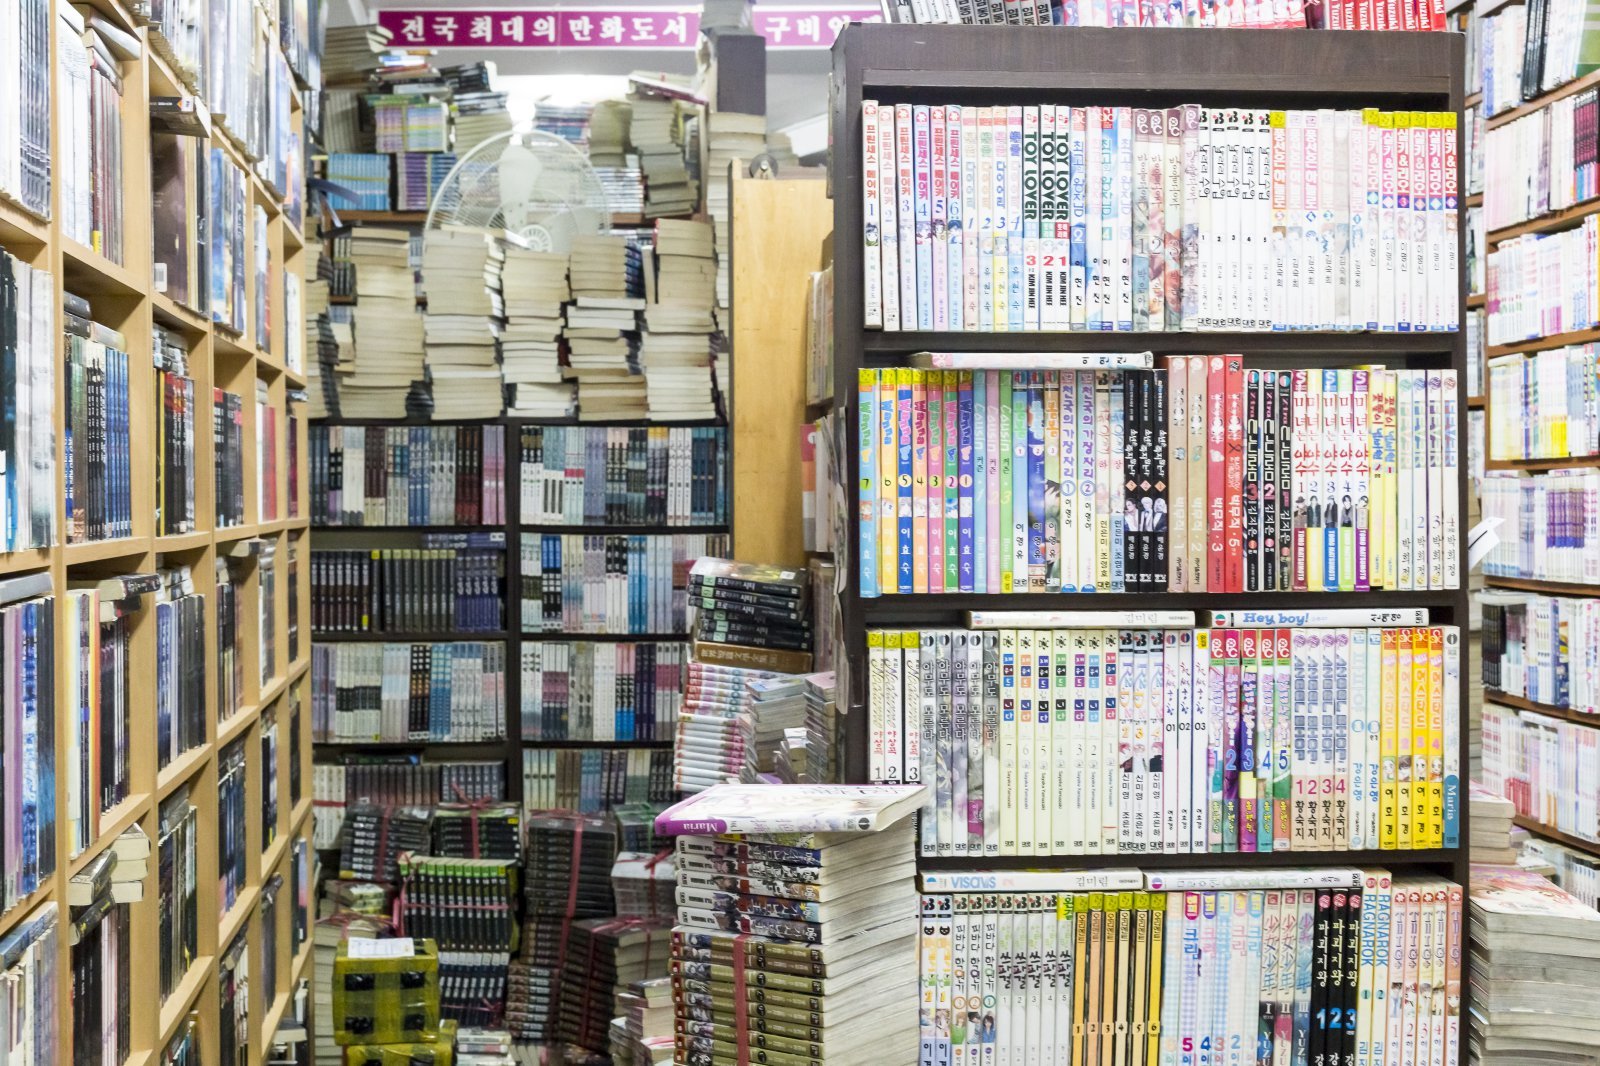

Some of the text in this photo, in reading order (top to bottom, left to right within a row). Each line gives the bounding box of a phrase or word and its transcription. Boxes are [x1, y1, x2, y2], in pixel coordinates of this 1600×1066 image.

[400, 16, 688, 42] 전국 최대의 만화도서
[1345, 1, 1354, 30] Yuzuk
[1359, 1, 1369, 30] Yuzuk
[1376, 1, 1386, 30] Yuzuk
[1024, 132, 1037, 220] TOY LOVER
[1042, 132, 1055, 220] TOY LOVER
[1056, 132, 1069, 220] TOY LOVER
[1026, 255, 1036, 266] 3
[1043, 255, 1054, 266] 2
[1060, 256, 1067, 266] 1
[1278, 612, 1309, 625] boy!
[1294, 655, 1305, 713] ANGEL
[1307, 655, 1318, 713] ANGEL
[1322, 655, 1333, 712] ANGEL
[1336, 654, 1347, 712] ANGEL
[922, 661, 936, 742] 아무도 모른다
[938, 660, 951, 741] 아무도 모른다
[954, 660, 967, 741] 아무도 모른다
[969, 661, 982, 741] 아무도 모른다
[985, 661, 998, 742] 아무도 모른다
[1165, 724, 1176, 732] 01
[1180, 722, 1190, 731] 02
[1194, 722, 1206, 730] 03
[875, 767, 881, 779] 1
[888, 766, 896, 779] 2
[909, 767, 918, 780] 3
[1213, 750, 1218, 770] 1
[1225, 749, 1237, 770] 2
[1242, 748, 1255, 770] 3
[1262, 750, 1271, 770] 4
[1279, 749, 1288, 770] 5
[1295, 779, 1305, 840] 1 황숙지
[1307, 780, 1318, 840] 2 황숙지
[1322, 779, 1332, 840] 3 황숙지
[1335, 779, 1346, 840] 4 황숙지
[956, 924, 966, 951] 피바다
[971, 924, 981, 951] 피바다
[985, 923, 996, 951] 피바다
[1361, 894, 1376, 967] RAGNAROK
[1376, 894, 1391, 967] RAGNAROK
[1316, 919, 1329, 1029] 파괴지왕 1
[1328, 918, 1345, 1028] 파괴지왕 2
[1345, 919, 1359, 1029] 파괴지왕 3
[1182, 1037, 1193, 1051] 5
[1200, 1036, 1211, 1050] 4
[1214, 1037, 1224, 1051] 3
[1231, 1035, 1241, 1049] 2
